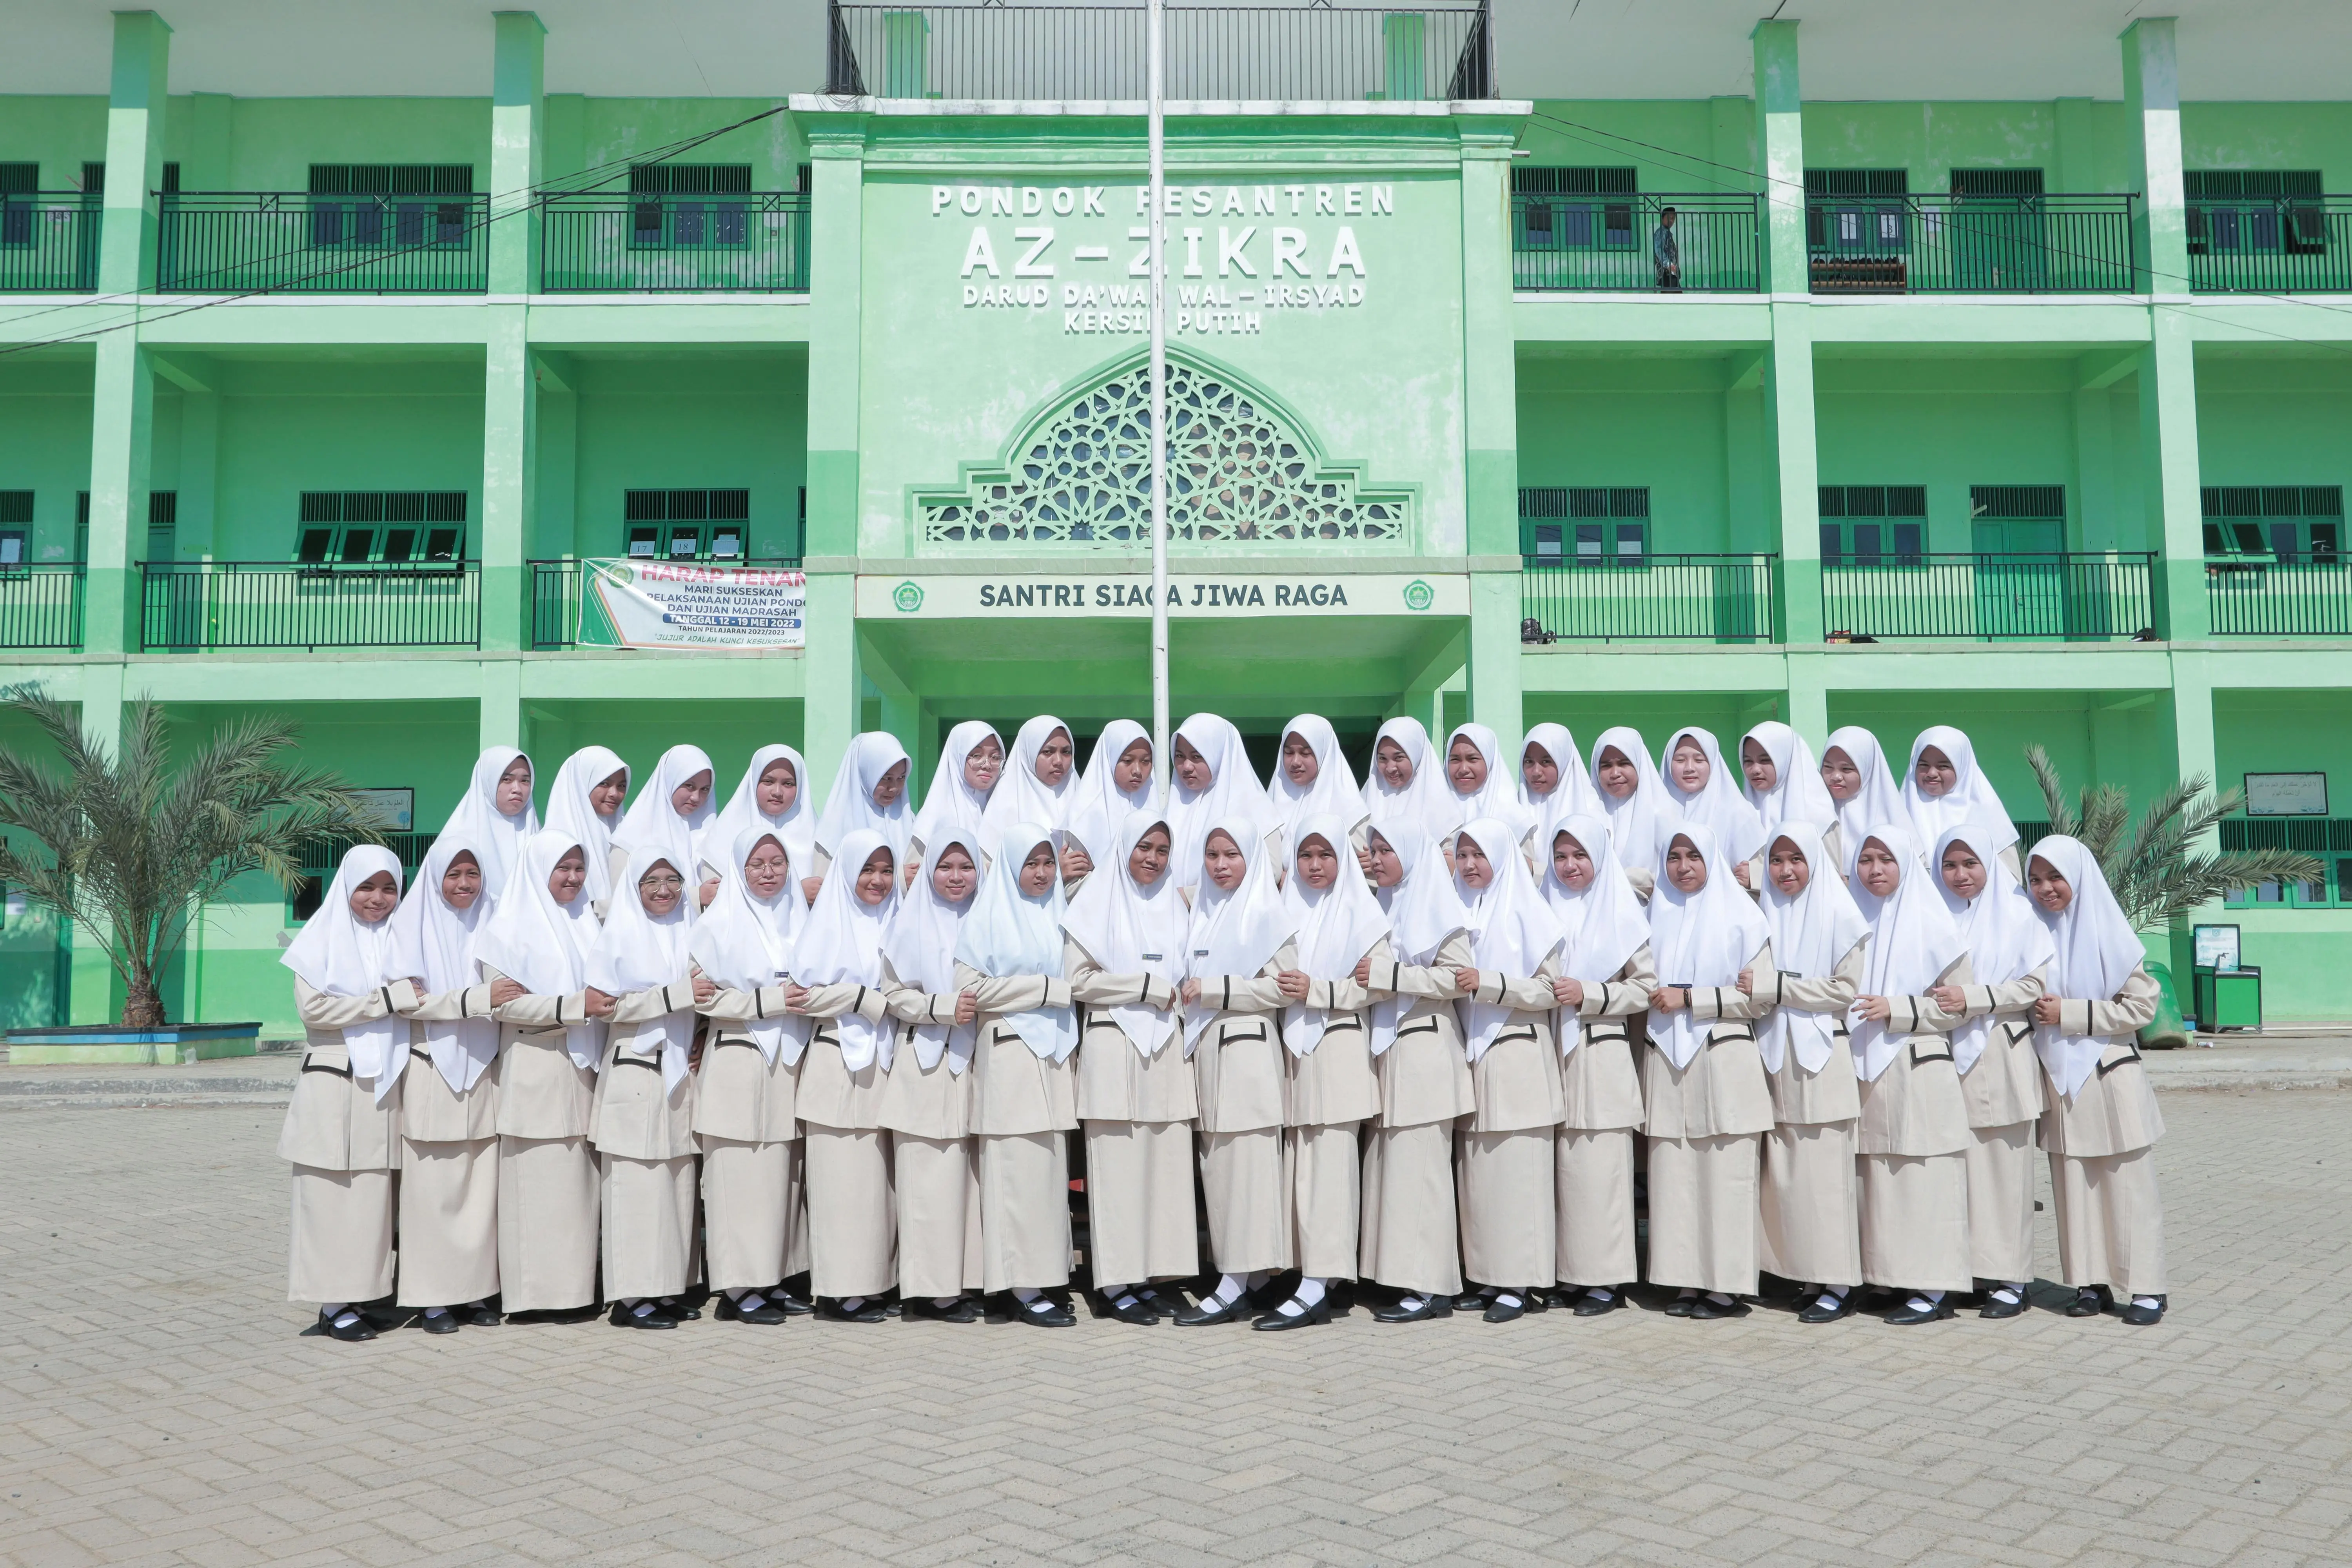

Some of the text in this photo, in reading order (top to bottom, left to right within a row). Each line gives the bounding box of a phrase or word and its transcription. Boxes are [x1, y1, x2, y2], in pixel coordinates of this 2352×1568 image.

[932, 185, 1394, 215] PONDOK PESANTREN
[963, 285, 1049, 306] DARUD
[1064, 285, 1151, 306] DA'WA
[1065, 312, 1261, 334] KERSI PUTIH
[642, 564, 724, 583] HARAP
[685, 585, 782, 597] MARI SUKSESKAN
[980, 584, 1085, 606] SANTRI
[1191, 584, 1265, 606] JIWA
[1275, 584, 1348, 606] RAGA
[668, 604, 796, 616] DAN UJIAN MADRASAH
[734, 597, 766, 606] UJIAN
[670, 615, 717, 624] TANGGAL
[750, 618, 768, 626] MEI
[771, 619, 795, 627] 2022
